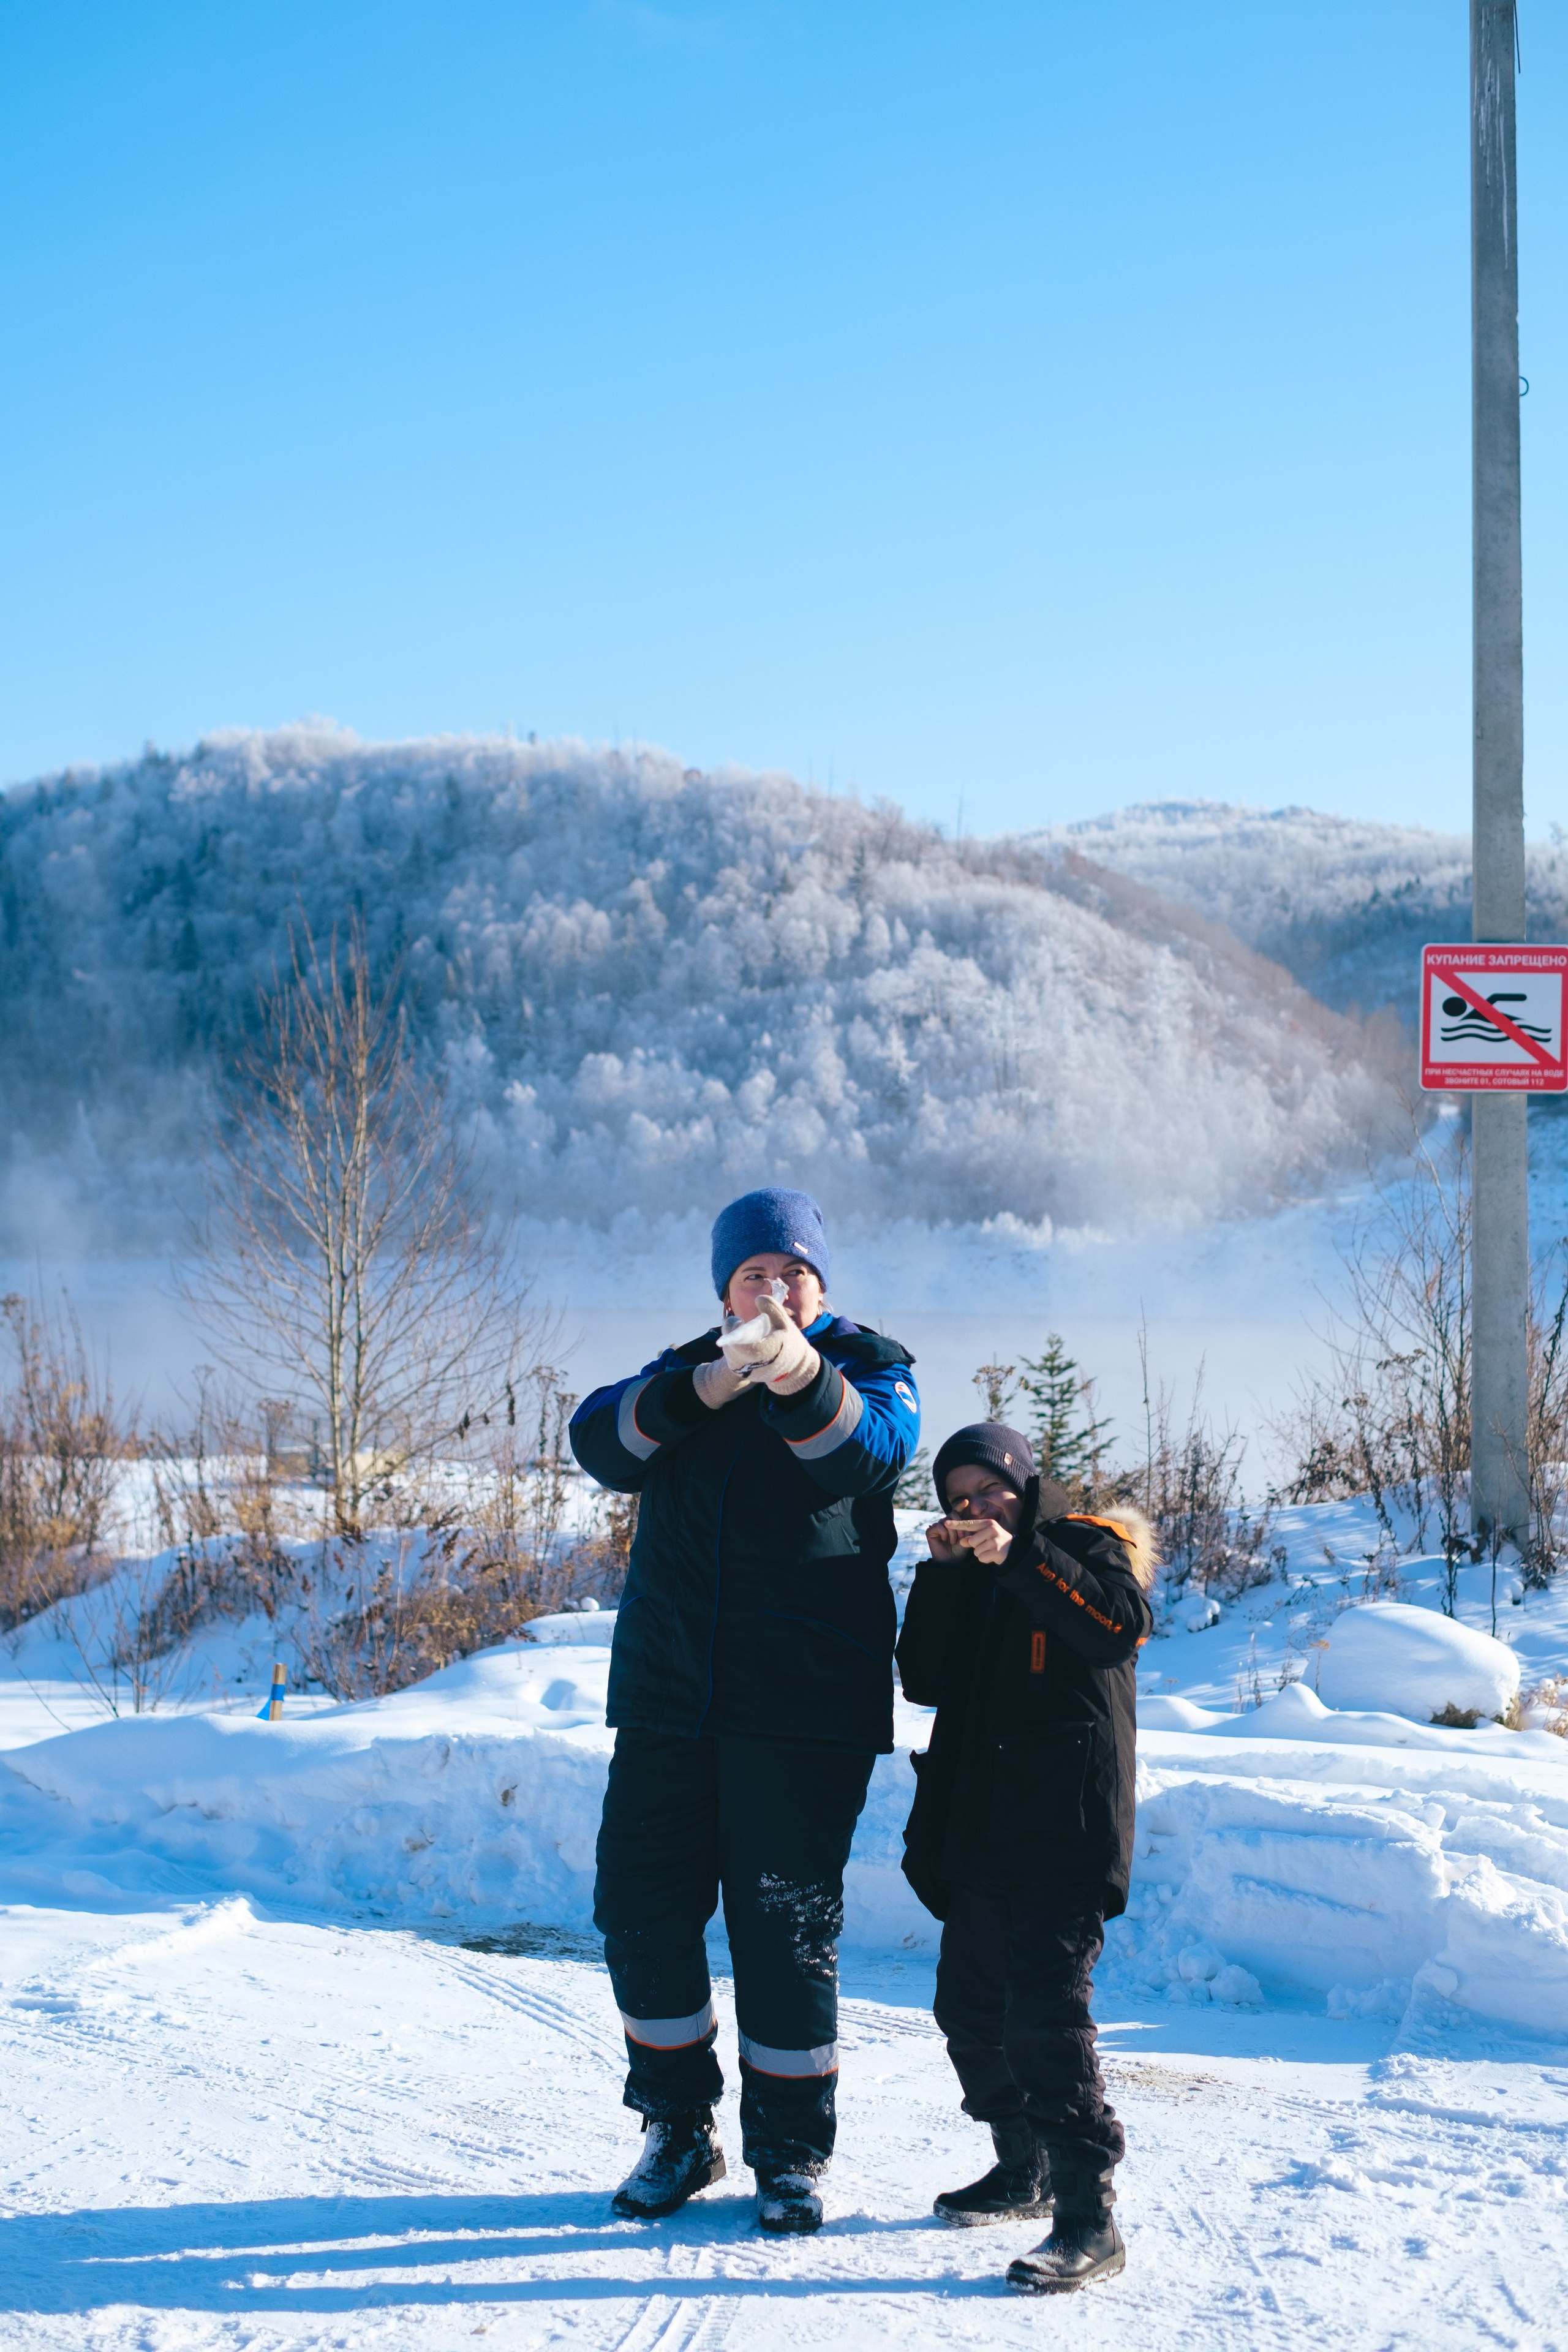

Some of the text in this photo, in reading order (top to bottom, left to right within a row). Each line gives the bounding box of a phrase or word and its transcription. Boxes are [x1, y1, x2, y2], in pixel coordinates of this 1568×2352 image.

[1427, 954, 1567, 968] КУПАНИЕ ЗАПРЕЩЕНО
[1544, 1069, 1564, 1078] ВОДЕ
[1492, 1077, 1529, 1085] СОТОВЫЙ
[1055, 1578, 1070, 1593] for
[1069, 1589, 1085, 1606] the
